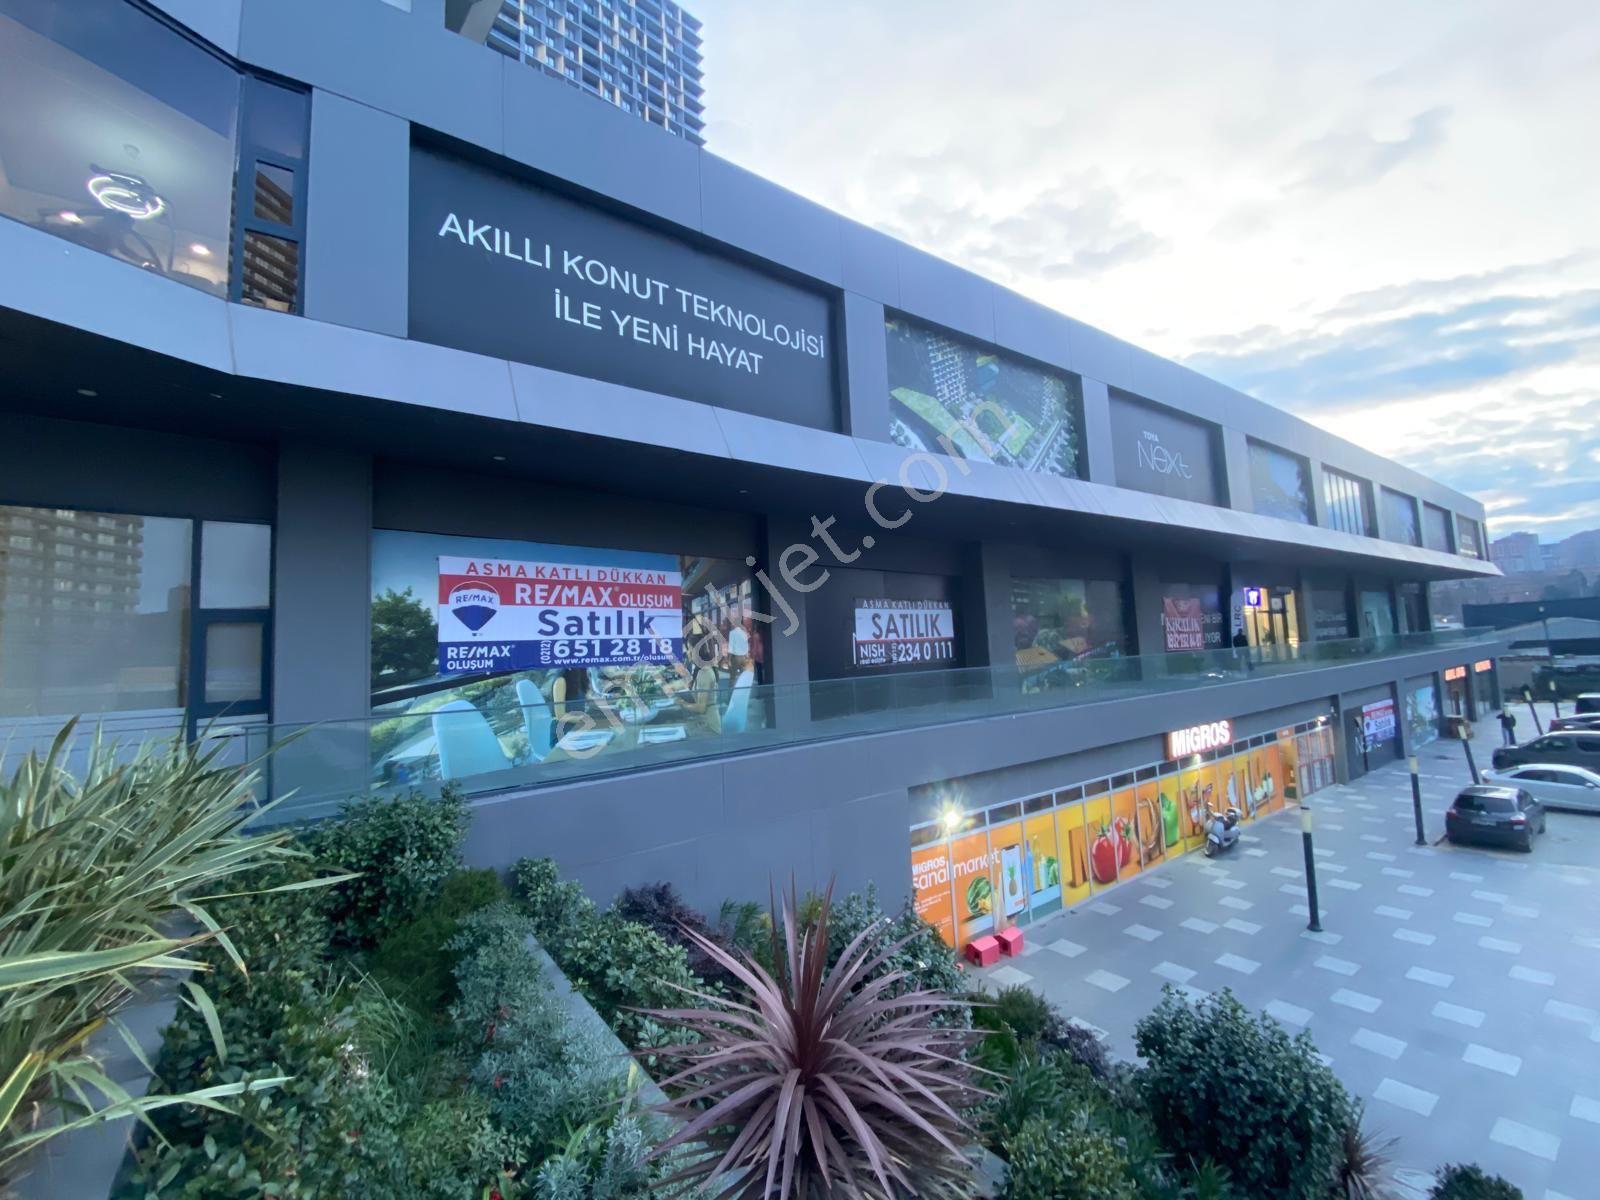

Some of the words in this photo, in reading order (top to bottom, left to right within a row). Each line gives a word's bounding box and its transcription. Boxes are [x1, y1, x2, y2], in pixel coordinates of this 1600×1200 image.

[438, 213, 551, 270] AKILLI
[563, 249, 669, 306] KONUT
[675, 287, 826, 360] TEKNOLOJİSİ
[554, 287, 602, 331] İLE
[610, 310, 679, 351] YENİ
[688, 332, 764, 375] HAYAT
[466, 561, 528, 578] ASMA
[535, 565, 591, 581] KATLI
[599, 567, 667, 585] DÜKKAN
[455, 593, 495, 605] RE/MAX
[515, 583, 613, 607] RE/MAX
[618, 593, 674, 609] OLUŞUM
[862, 600, 889, 609] ASMA
[537, 609, 656, 637] Satılık
[871, 612, 942, 639] SATILIK
[447, 646, 511, 659] RE/MAX
[540, 640, 552, 664] (0212)
[553, 639, 601, 658] 651
[609, 638, 641, 657] 28
[649, 638, 673, 656] 18
[553, 652, 674, 665] www.remax.com.tr/olusum
[860, 642, 886, 659] NISH
[898, 641, 921, 662] 234
[446, 659, 494, 670] OLUŞUM
[953, 847, 1001, 879] market
